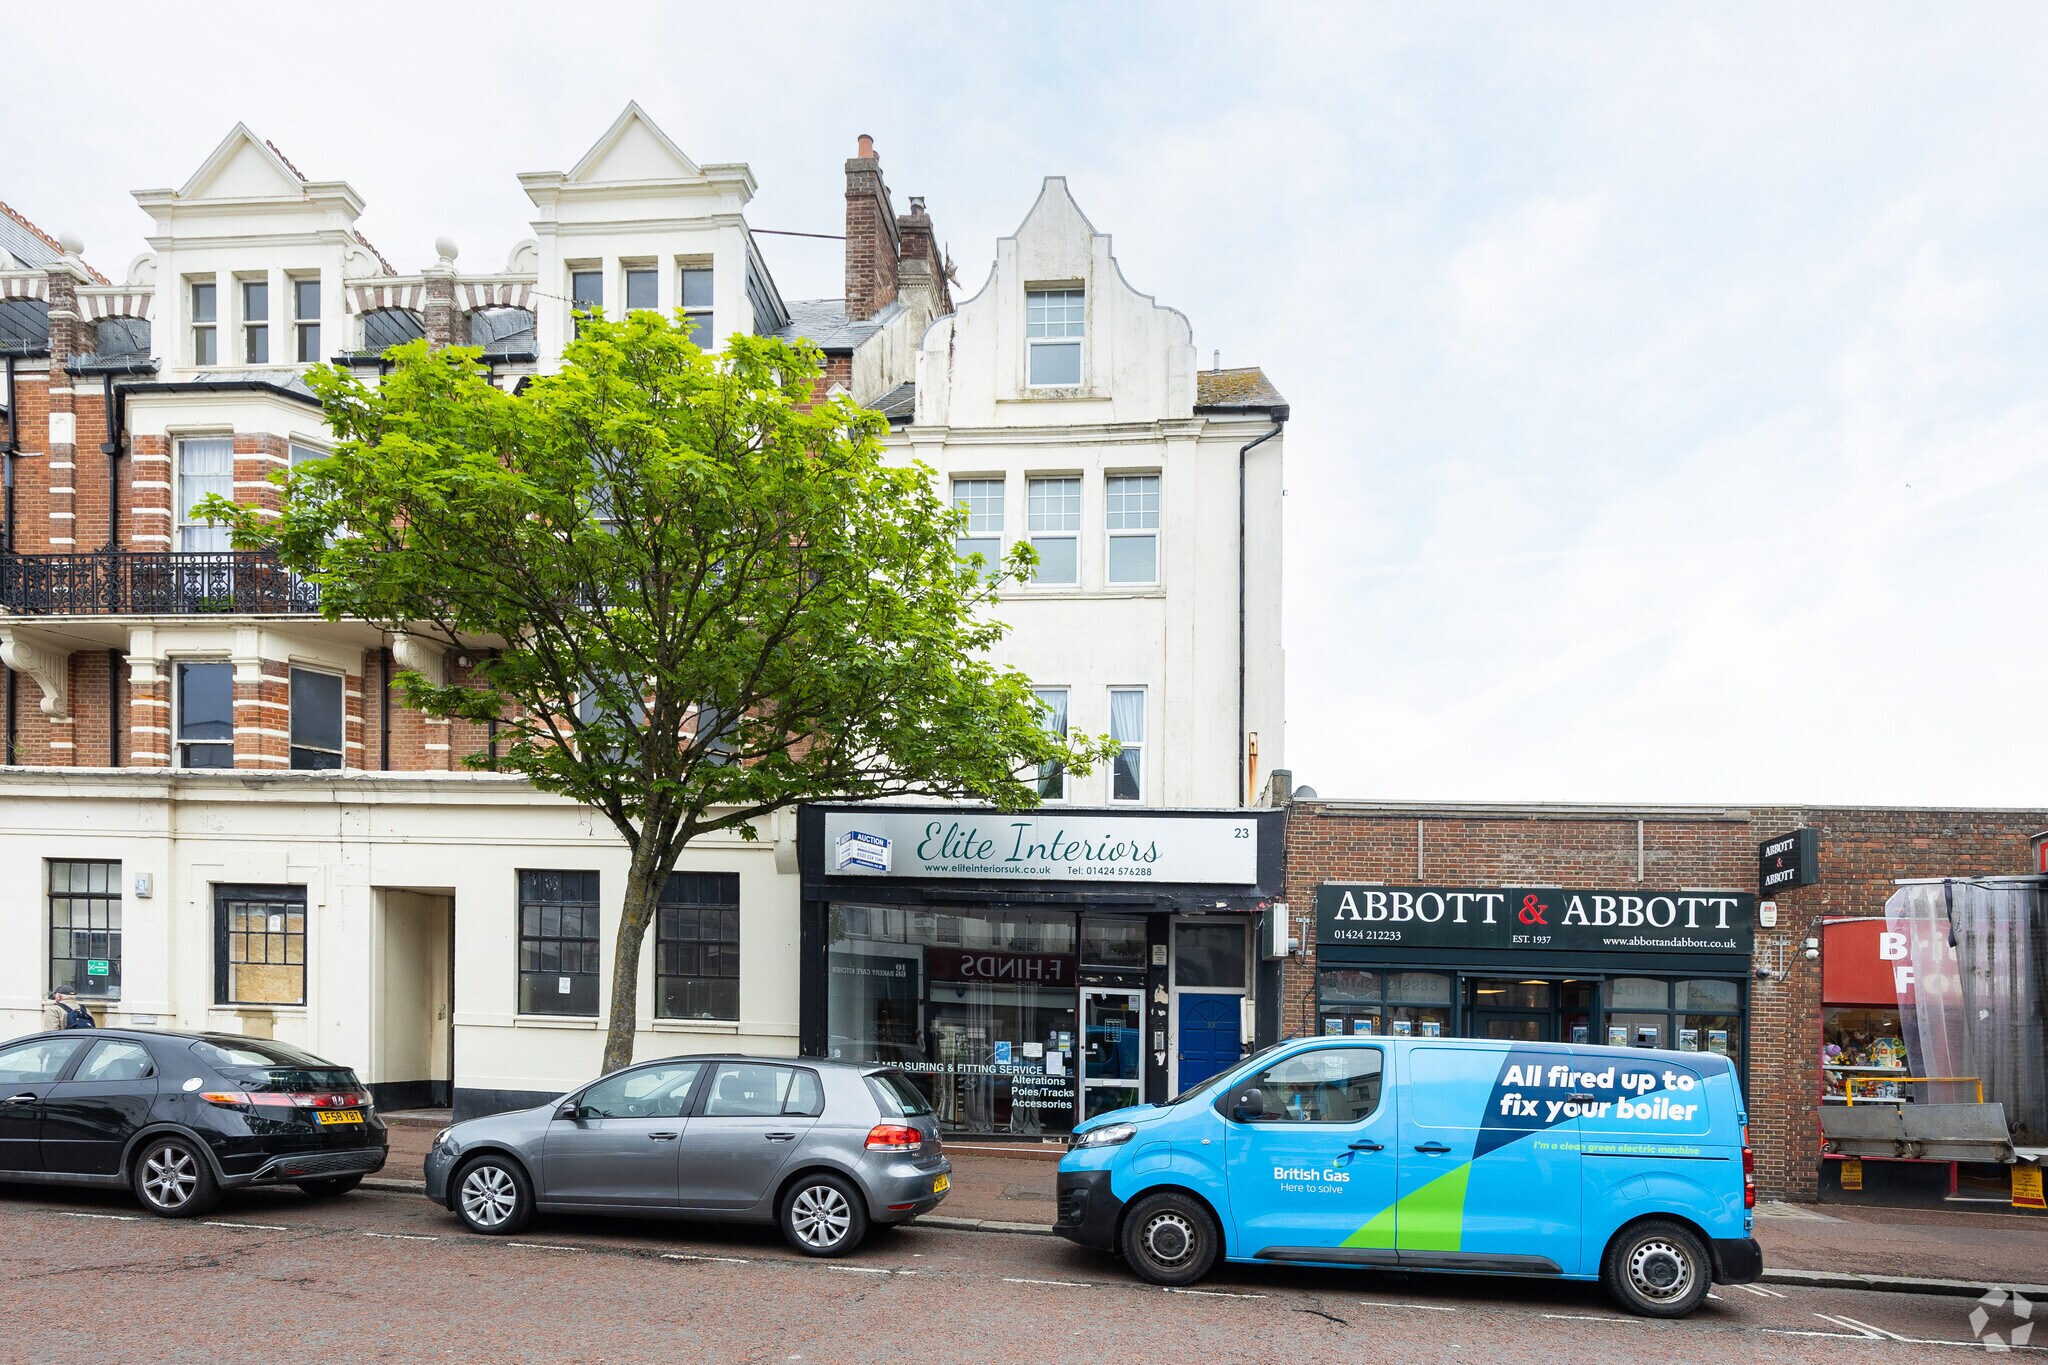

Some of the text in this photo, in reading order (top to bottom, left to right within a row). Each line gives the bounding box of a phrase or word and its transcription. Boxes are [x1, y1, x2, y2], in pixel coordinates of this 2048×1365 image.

[1234, 828, 1250, 839] 23
[857, 833, 884, 847] AUCTION
[917, 821, 1163, 863] Elite Interiors
[1765, 838, 1794, 857] ABBOTT
[1776, 857, 1782, 868] &
[924, 863, 1152, 877] www.eliteinteriorsuk.co.uk Tel: 01424 576288
[1765, 868, 1795, 886] ABBOTT
[1334, 890, 1738, 929] ABBOTT & ABBOTT
[1334, 929, 1401, 941] 01424 212233
[1512, 935, 1551, 944] EST. 1937
[1603, 937, 1736, 949] www.abbottandabbott.co.uk
[947, 1063, 954, 1072] &
[957, 1064, 996, 1074] FITTING
[999, 1065, 1043, 1075] SERVICE
[1012, 1076, 1066, 1086] Alterations
[1502, 1065, 1695, 1096] All fired up to
[1011, 1087, 1075, 1098] Poles/Tracks
[1011, 1099, 1072, 1109] Accessories
[1500, 1093, 1698, 1122] fix your boiler
[318, 1111, 361, 1123] LF58 YBT
[1559, 1141, 1586, 1151] clean
[1587, 1143, 1616, 1154] green
[1617, 1143, 1655, 1154] electric
[1656, 1145, 1700, 1155] machine
[1273, 1167, 1350, 1182] British Gas
[1280, 1183, 1343, 1194] Here to solve
